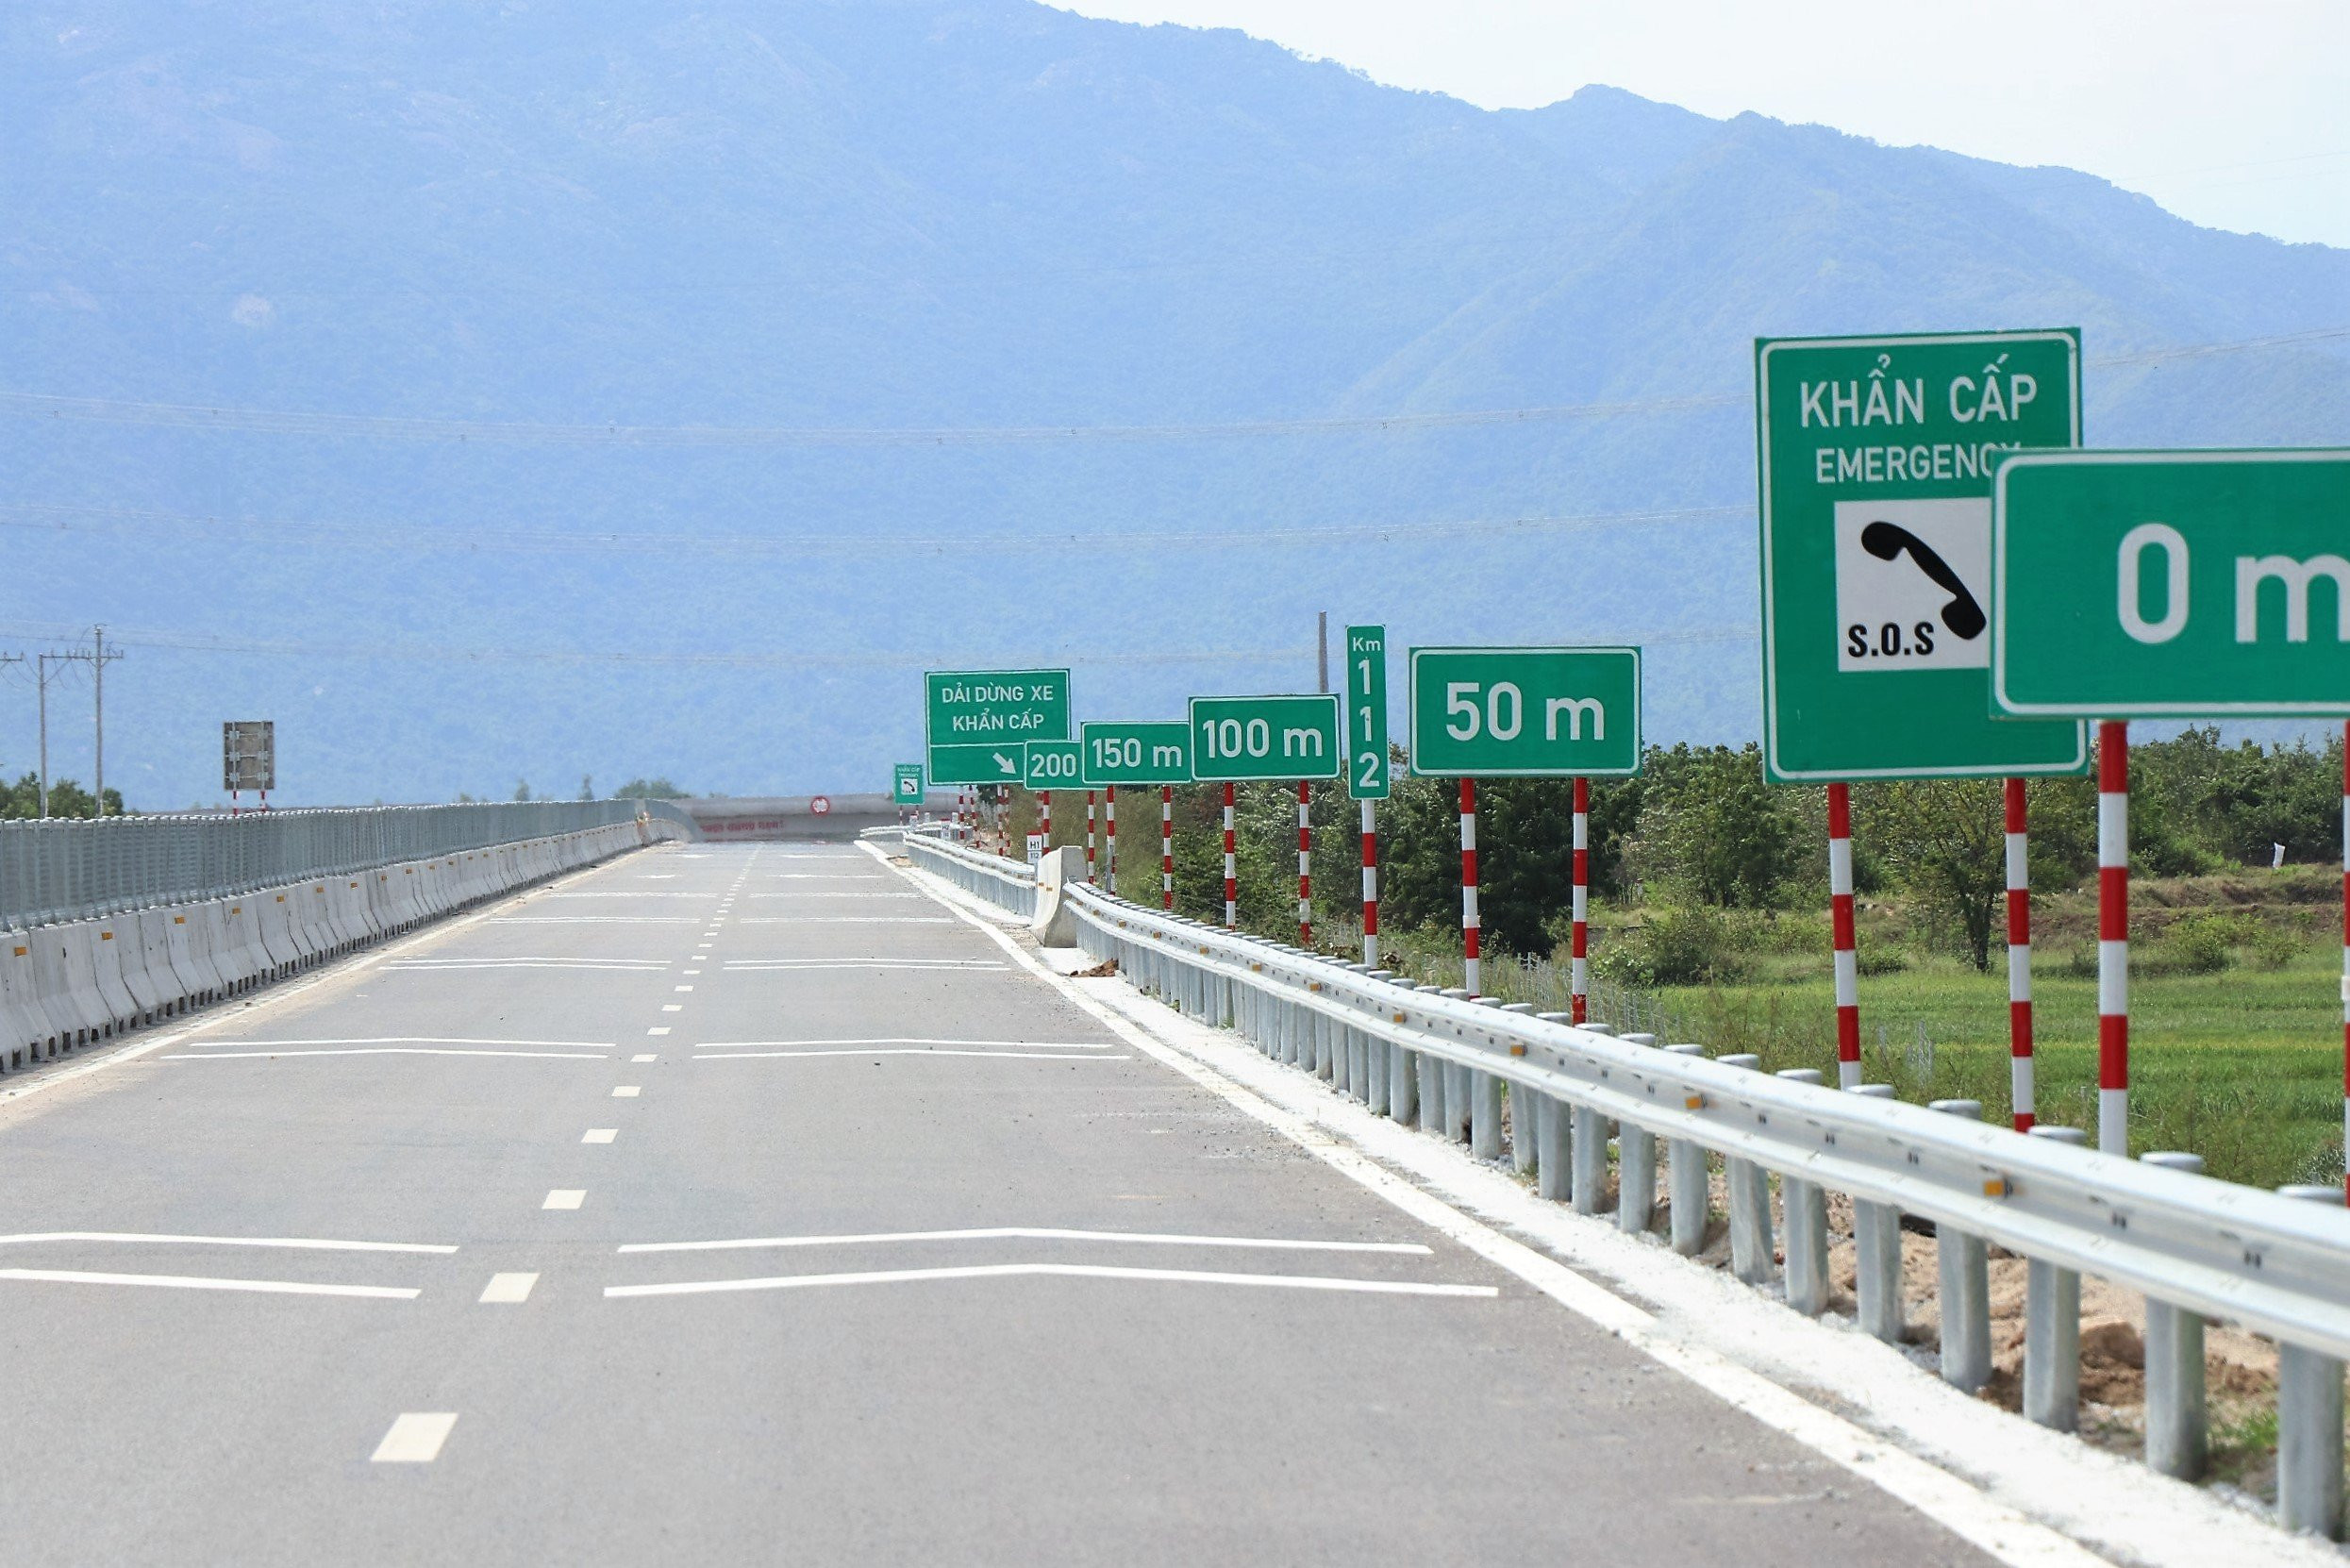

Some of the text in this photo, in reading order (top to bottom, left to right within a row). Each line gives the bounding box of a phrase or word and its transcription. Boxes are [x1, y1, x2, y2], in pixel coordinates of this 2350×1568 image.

[1800, 353, 2038, 427] KHẨN CẤP
[1816, 442, 2021, 483] EMERGENC
[2117, 523, 2350, 644] 0 m
[1352, 636, 1381, 652] Km
[1847, 621, 1935, 659] S.O.S
[942, 681, 1054, 704] DẢI DỪNG XE
[952, 707, 1044, 732] KHẨN CẤP
[1446, 681, 1605, 742] 50 m
[1092, 737, 1182, 768] 150 m
[1202, 718, 1323, 759] 100 m
[1030, 753, 1076, 777] 200
[1030, 841, 1040, 849] H1
